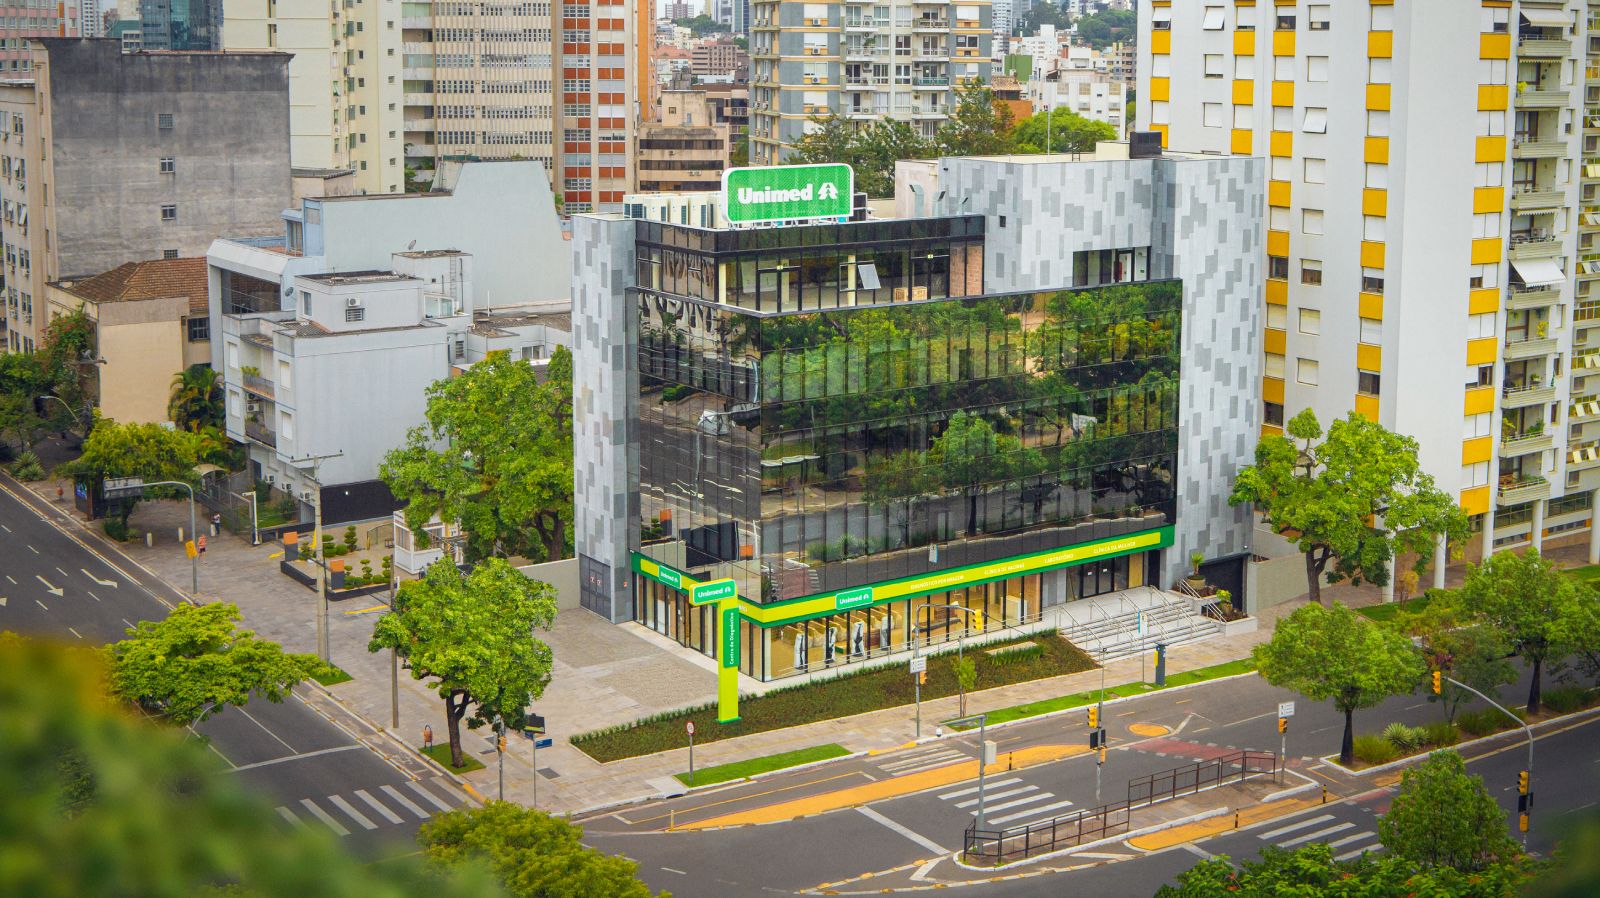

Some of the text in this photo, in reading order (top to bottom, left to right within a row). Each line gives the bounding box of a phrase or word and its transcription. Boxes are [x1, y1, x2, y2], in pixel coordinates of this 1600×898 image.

[738, 183, 813, 204] Unimed
[660, 571, 674, 583] Unimed
[698, 588, 723, 598] Unimed
[839, 594, 863, 605] Unimed
